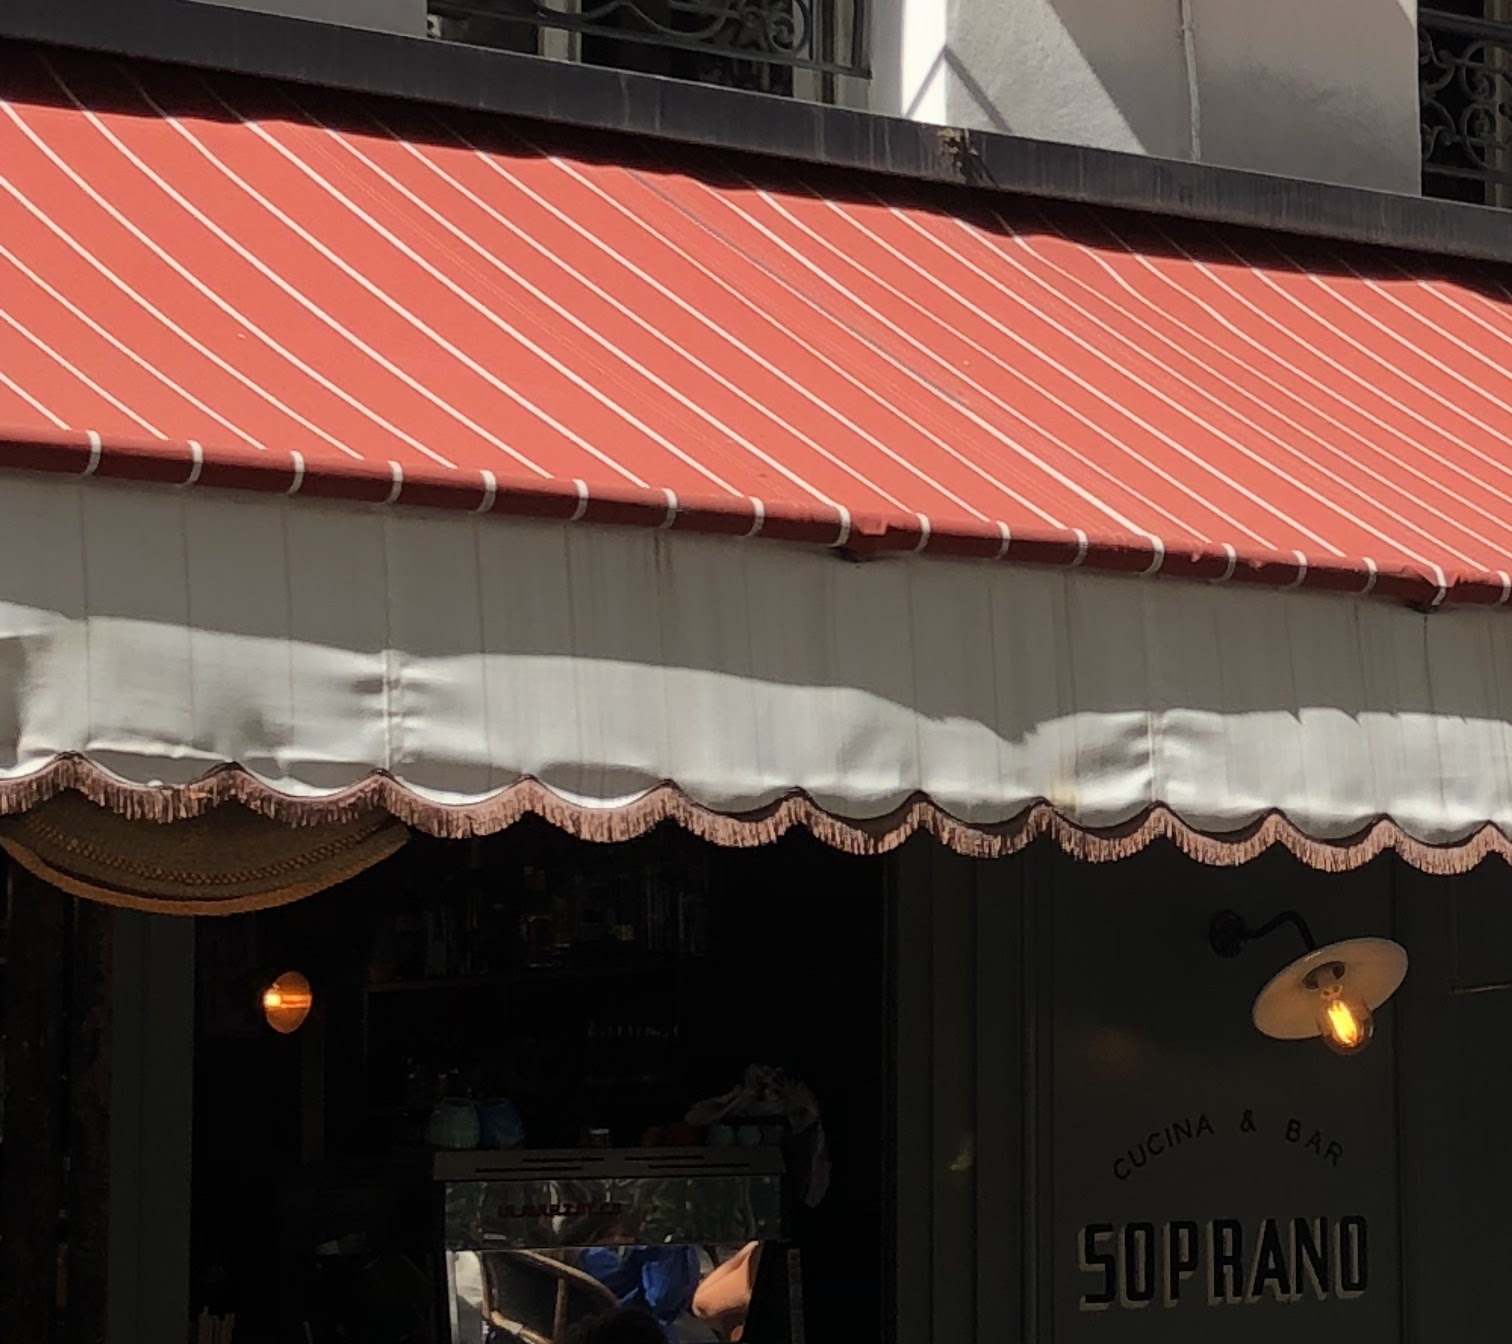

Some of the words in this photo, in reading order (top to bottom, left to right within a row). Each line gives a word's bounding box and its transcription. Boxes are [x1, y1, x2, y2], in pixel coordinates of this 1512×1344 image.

[1113, 1113, 1215, 1181] CUCINA
[1239, 1109, 1257, 1134] &
[1285, 1117, 1345, 1167] BAR
[1077, 1214, 1369, 1312] SOPRANO
